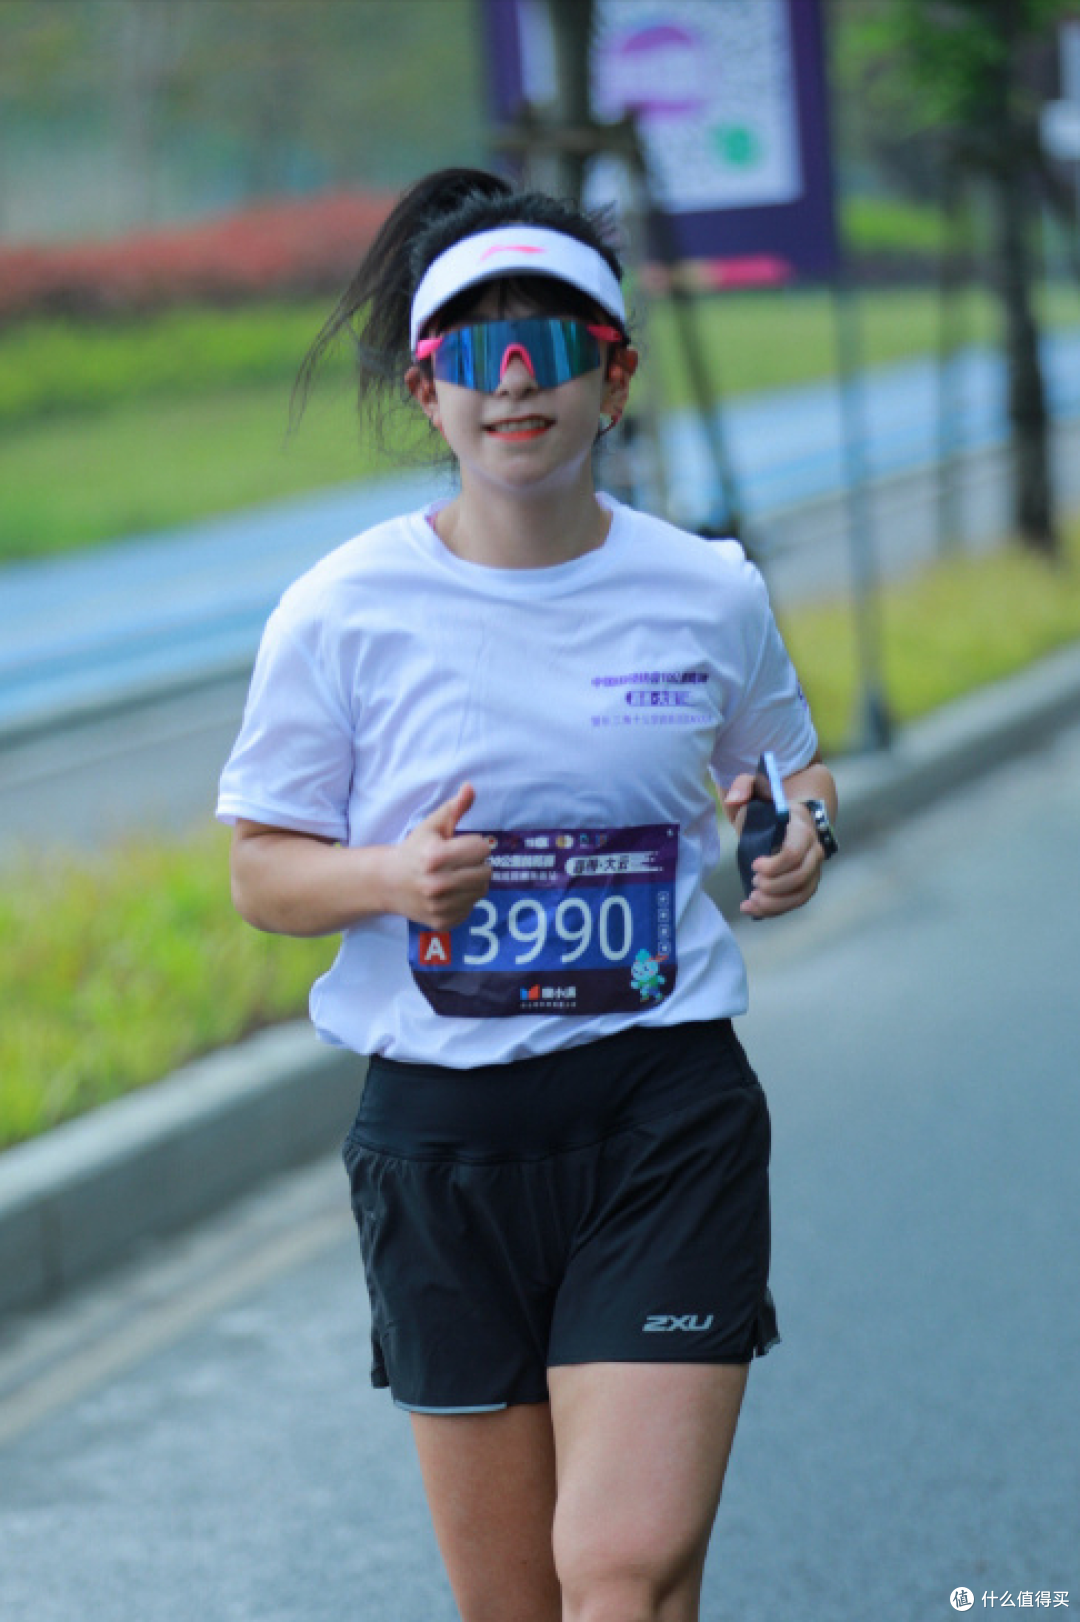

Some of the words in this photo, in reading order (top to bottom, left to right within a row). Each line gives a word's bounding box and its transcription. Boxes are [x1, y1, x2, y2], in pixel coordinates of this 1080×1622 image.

[462, 895, 634, 966] 3990
[423, 936, 447, 961] A
[642, 1314, 714, 1332] 2XU
